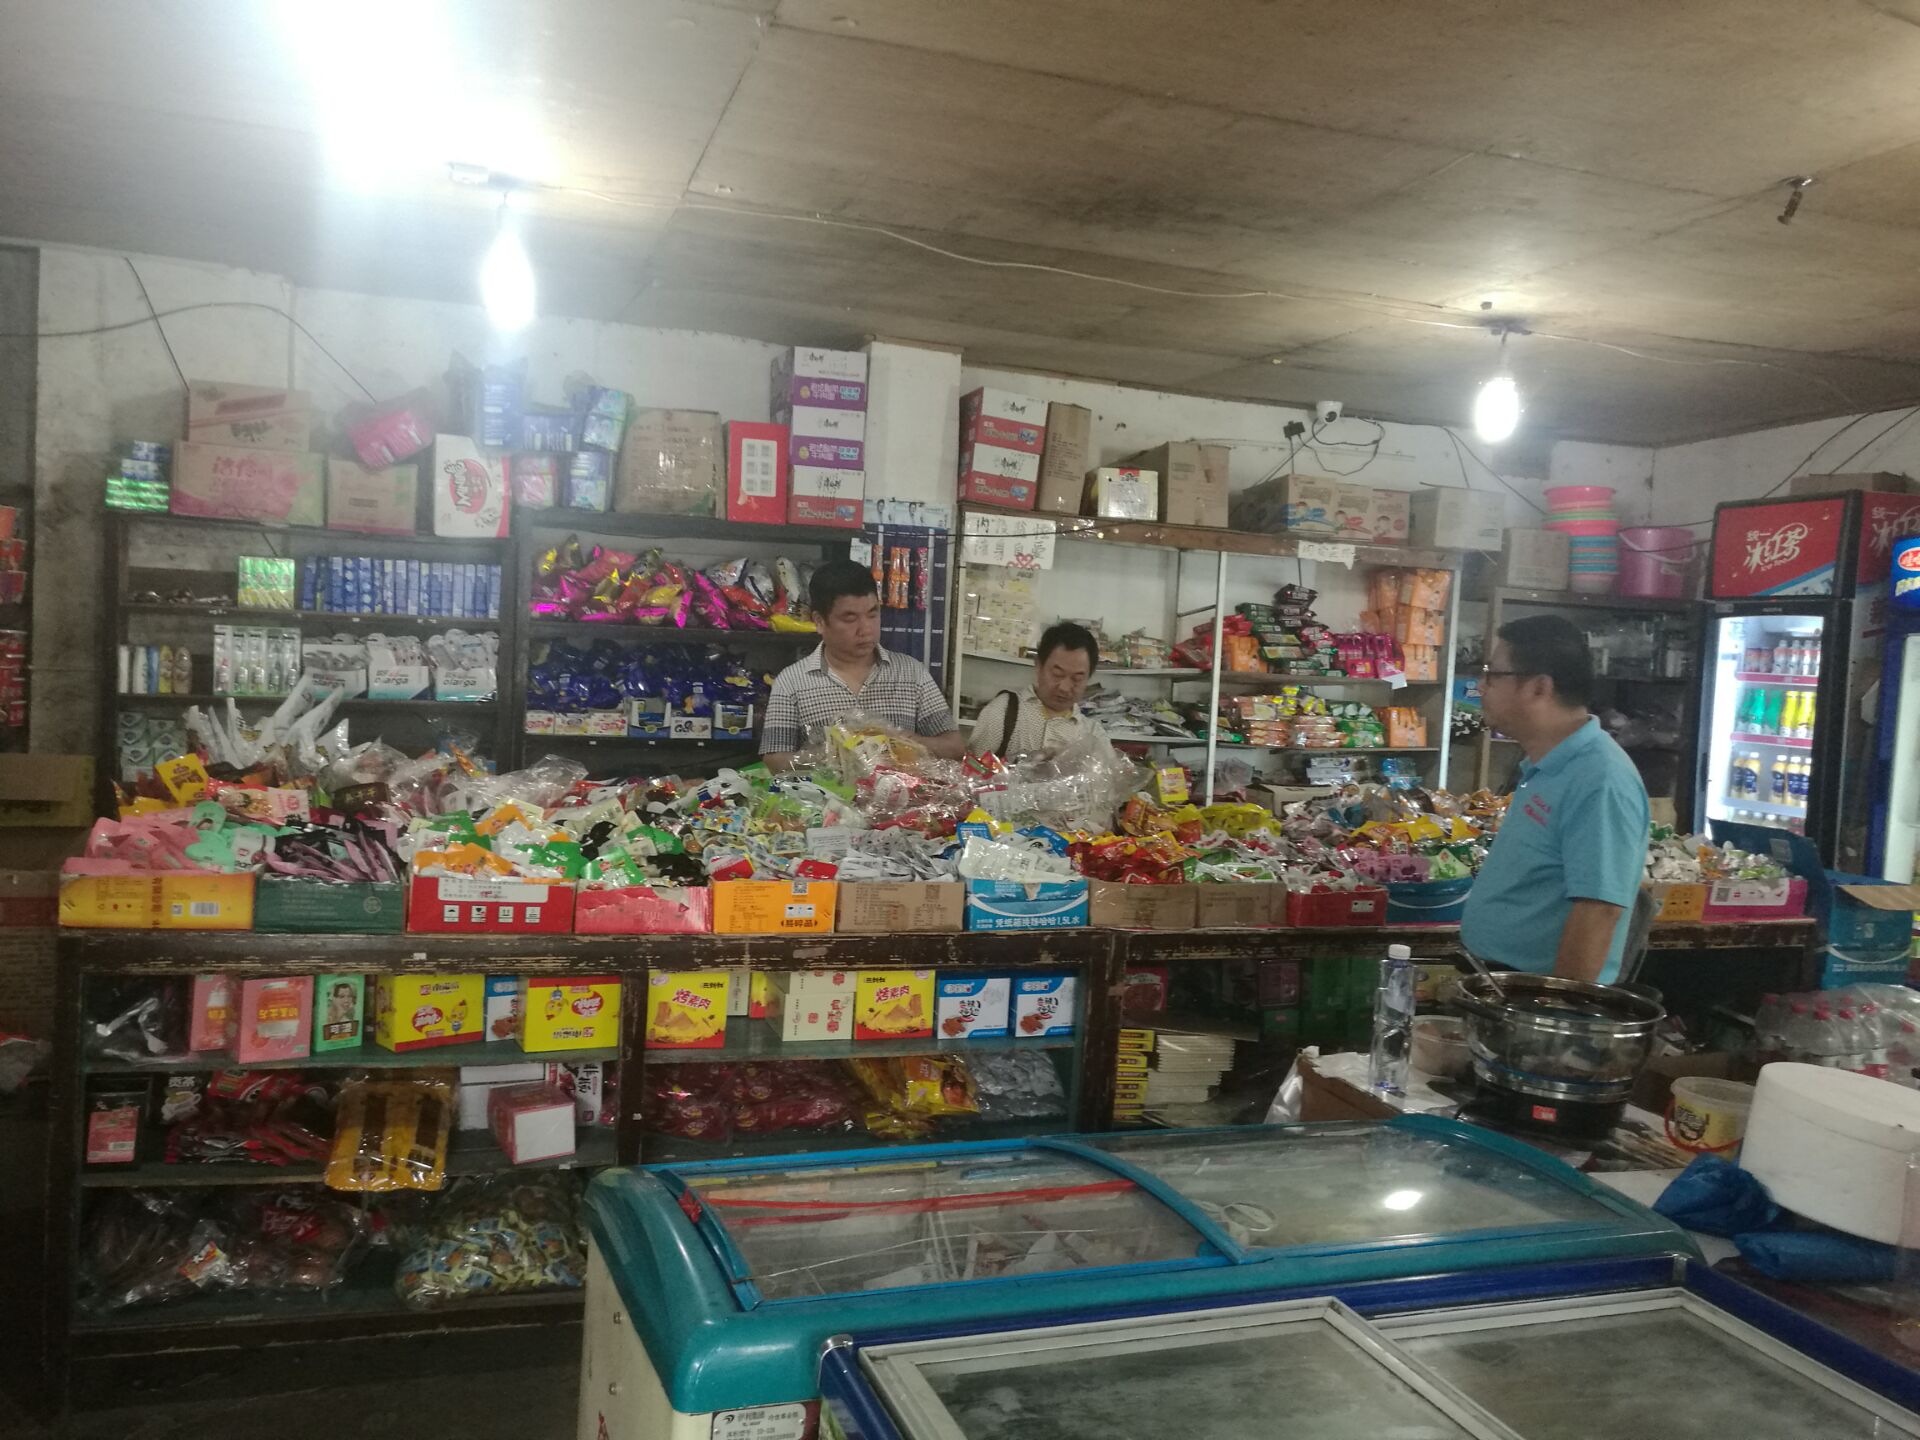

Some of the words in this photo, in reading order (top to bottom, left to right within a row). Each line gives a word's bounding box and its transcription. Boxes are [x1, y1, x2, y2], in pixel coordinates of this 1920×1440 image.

[1745, 529, 1771, 541] 统一
[1743, 522, 1809, 574] 冰红茶
[672, 988, 712, 1011] 烤素肉
[875, 984, 911, 1003] 烤素肉
